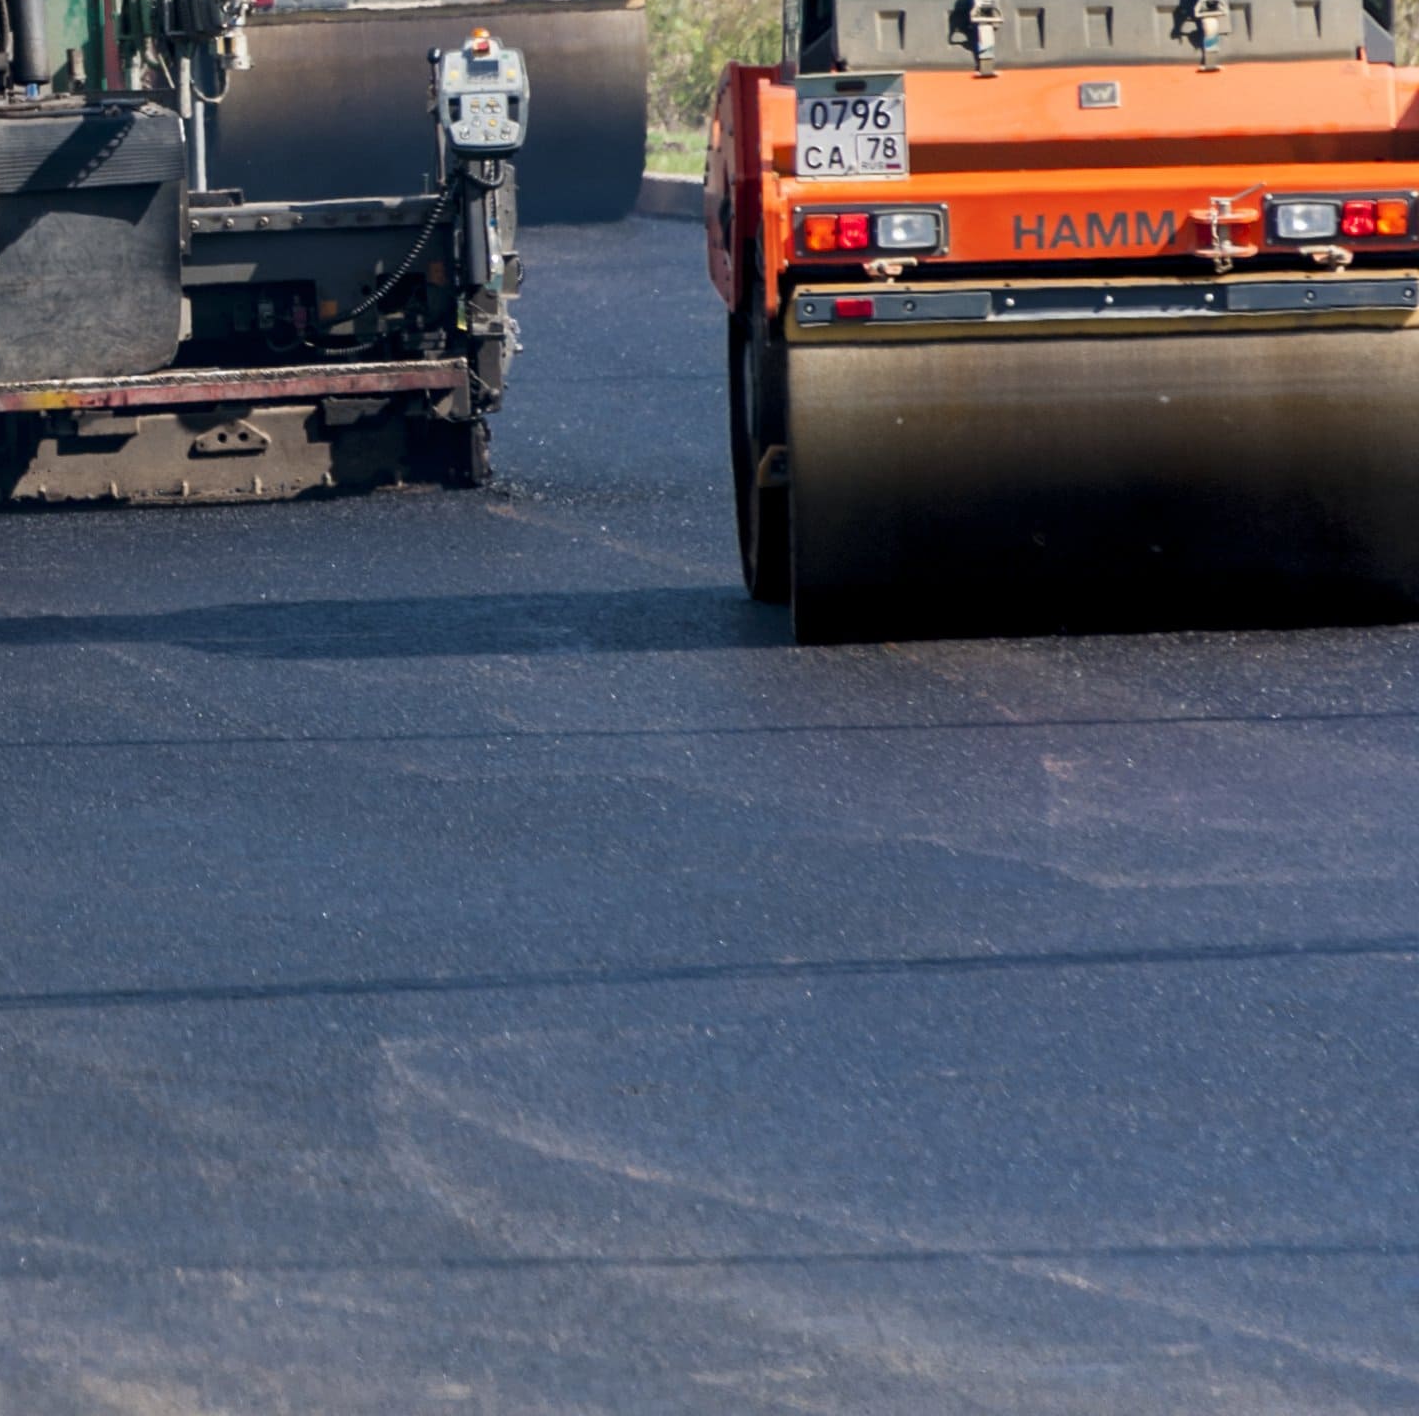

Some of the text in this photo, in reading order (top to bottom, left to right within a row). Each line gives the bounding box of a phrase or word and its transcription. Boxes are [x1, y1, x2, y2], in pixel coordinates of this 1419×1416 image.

[810, 98, 891, 130] 0796
[867, 136, 897, 160] 78
[1013, 209, 1176, 251] HAMM
